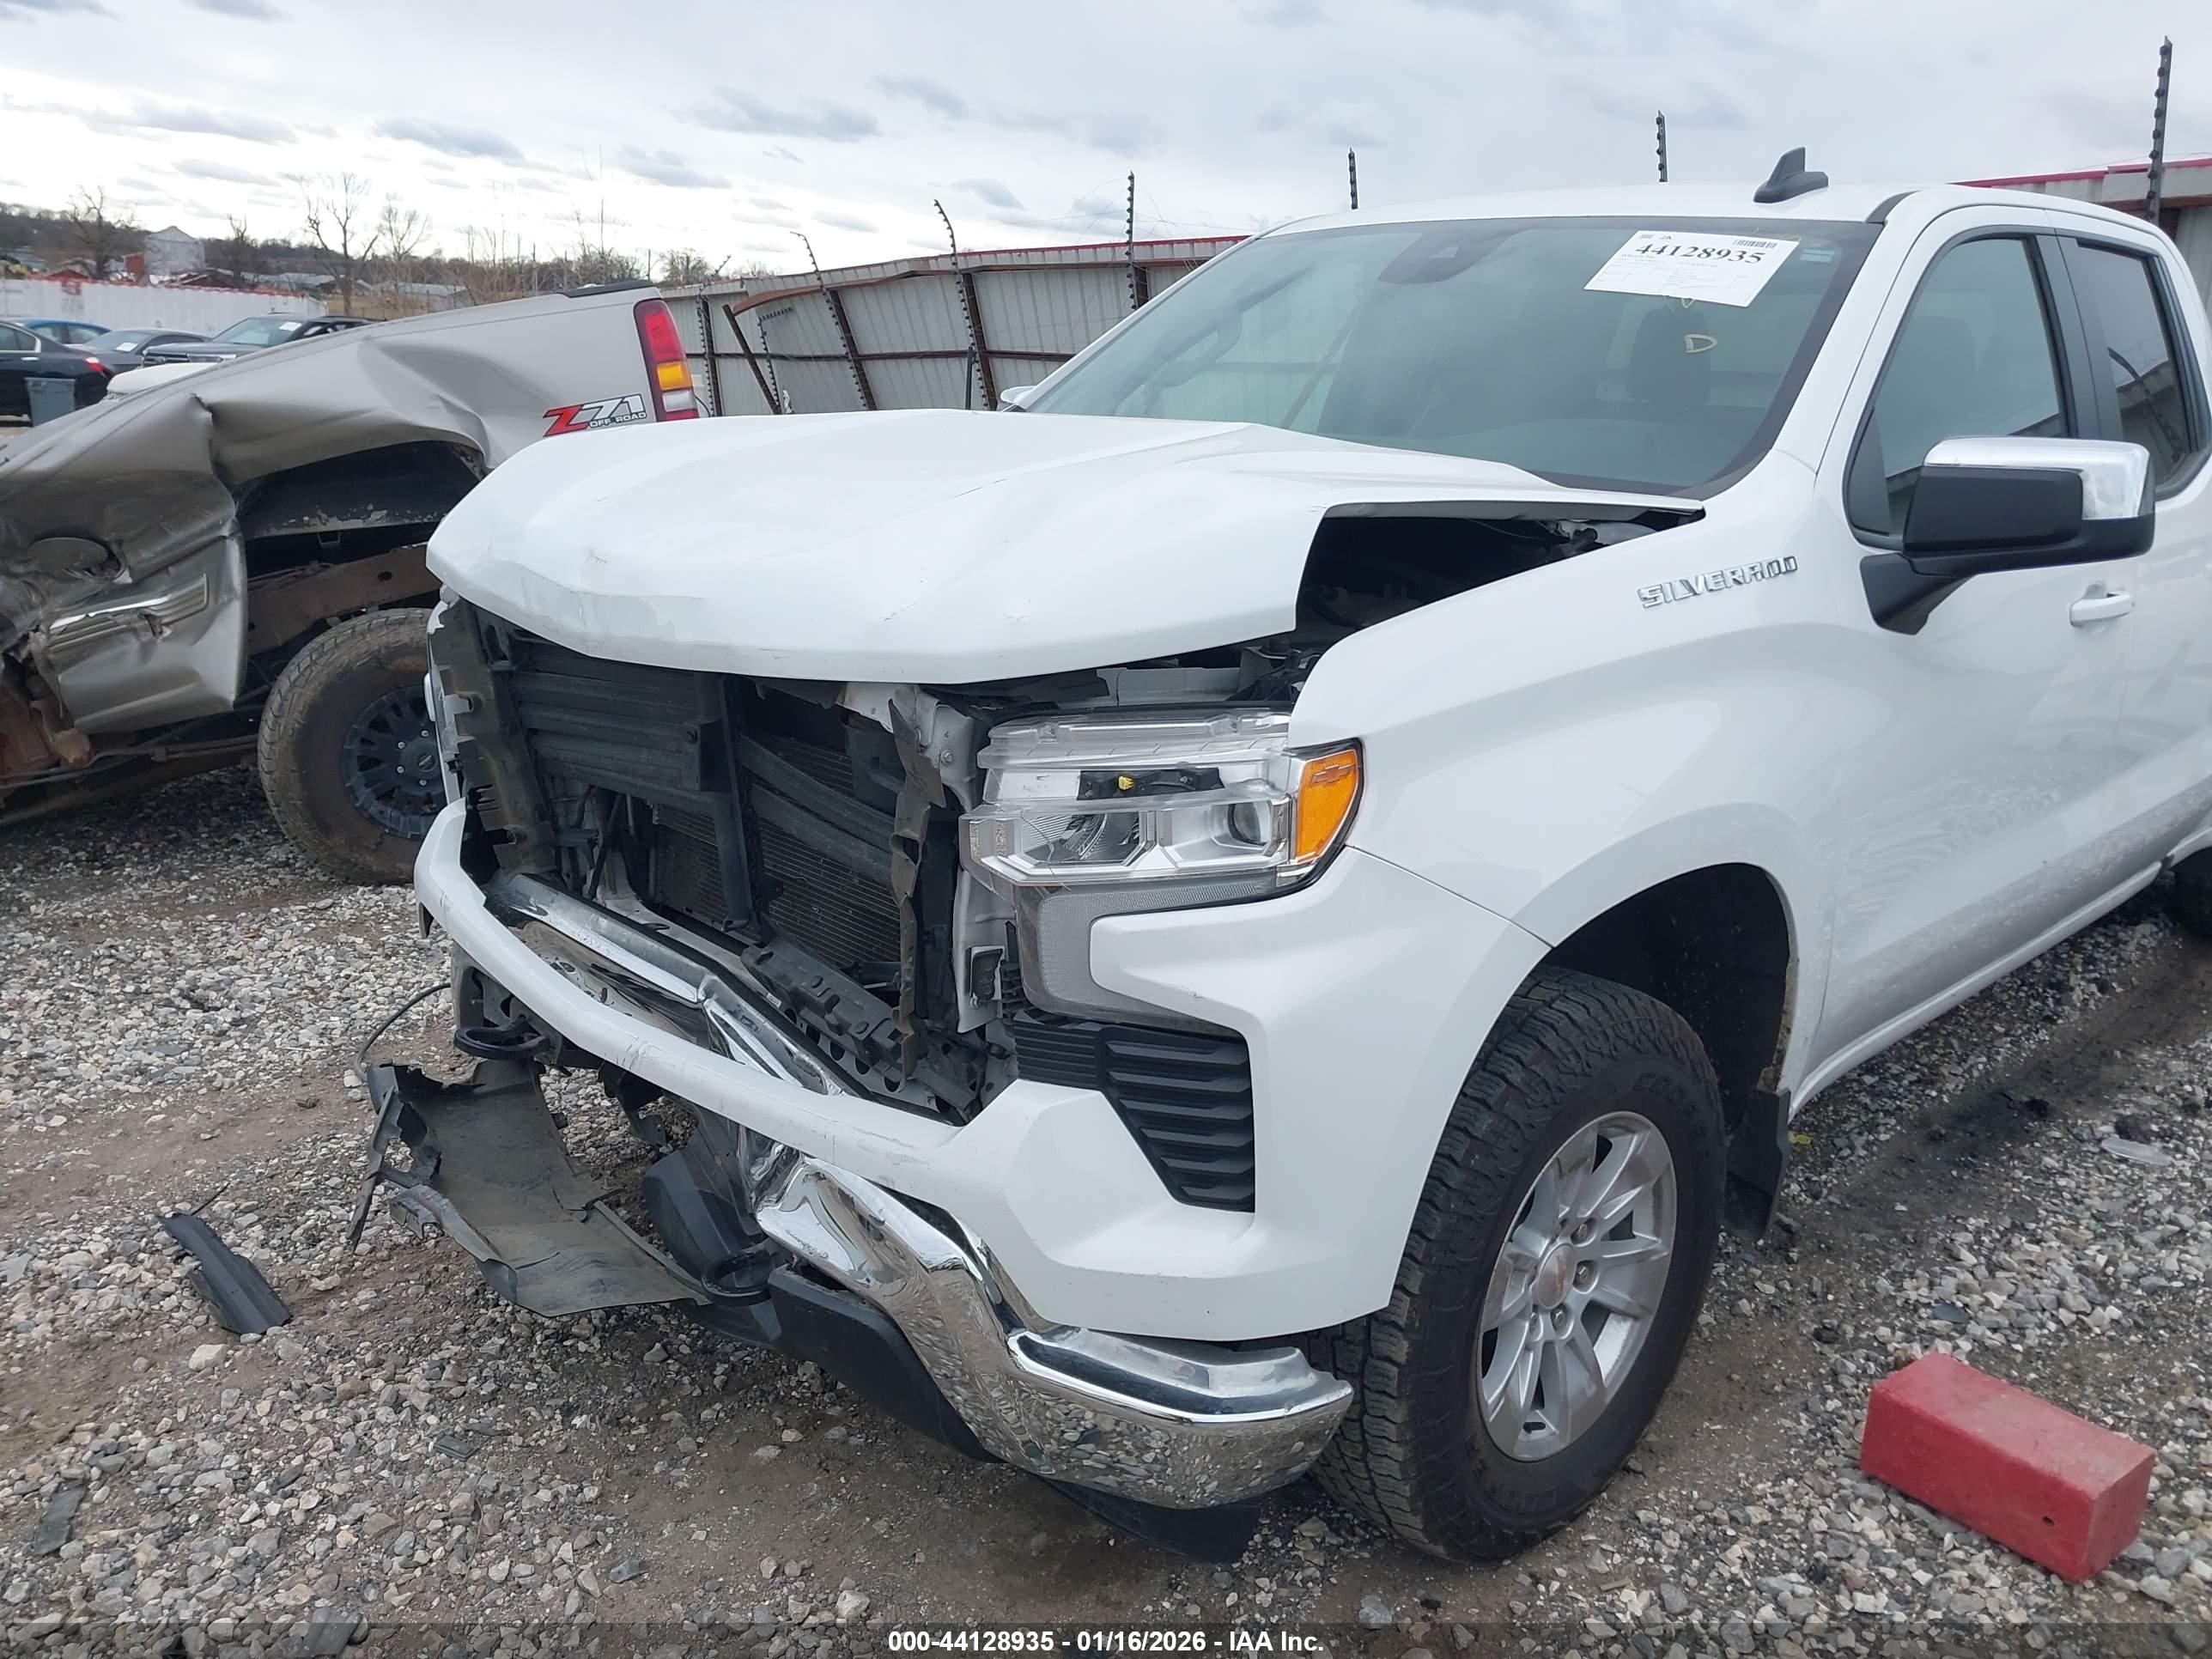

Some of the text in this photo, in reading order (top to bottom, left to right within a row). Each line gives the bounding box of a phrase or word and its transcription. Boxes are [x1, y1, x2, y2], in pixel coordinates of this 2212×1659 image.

[1635, 243, 1766, 264] 44128935
[543, 393, 646, 437] Z71
[589, 411, 647, 428] OFF ROAD
[1637, 555, 1799, 609] SILVERADO
